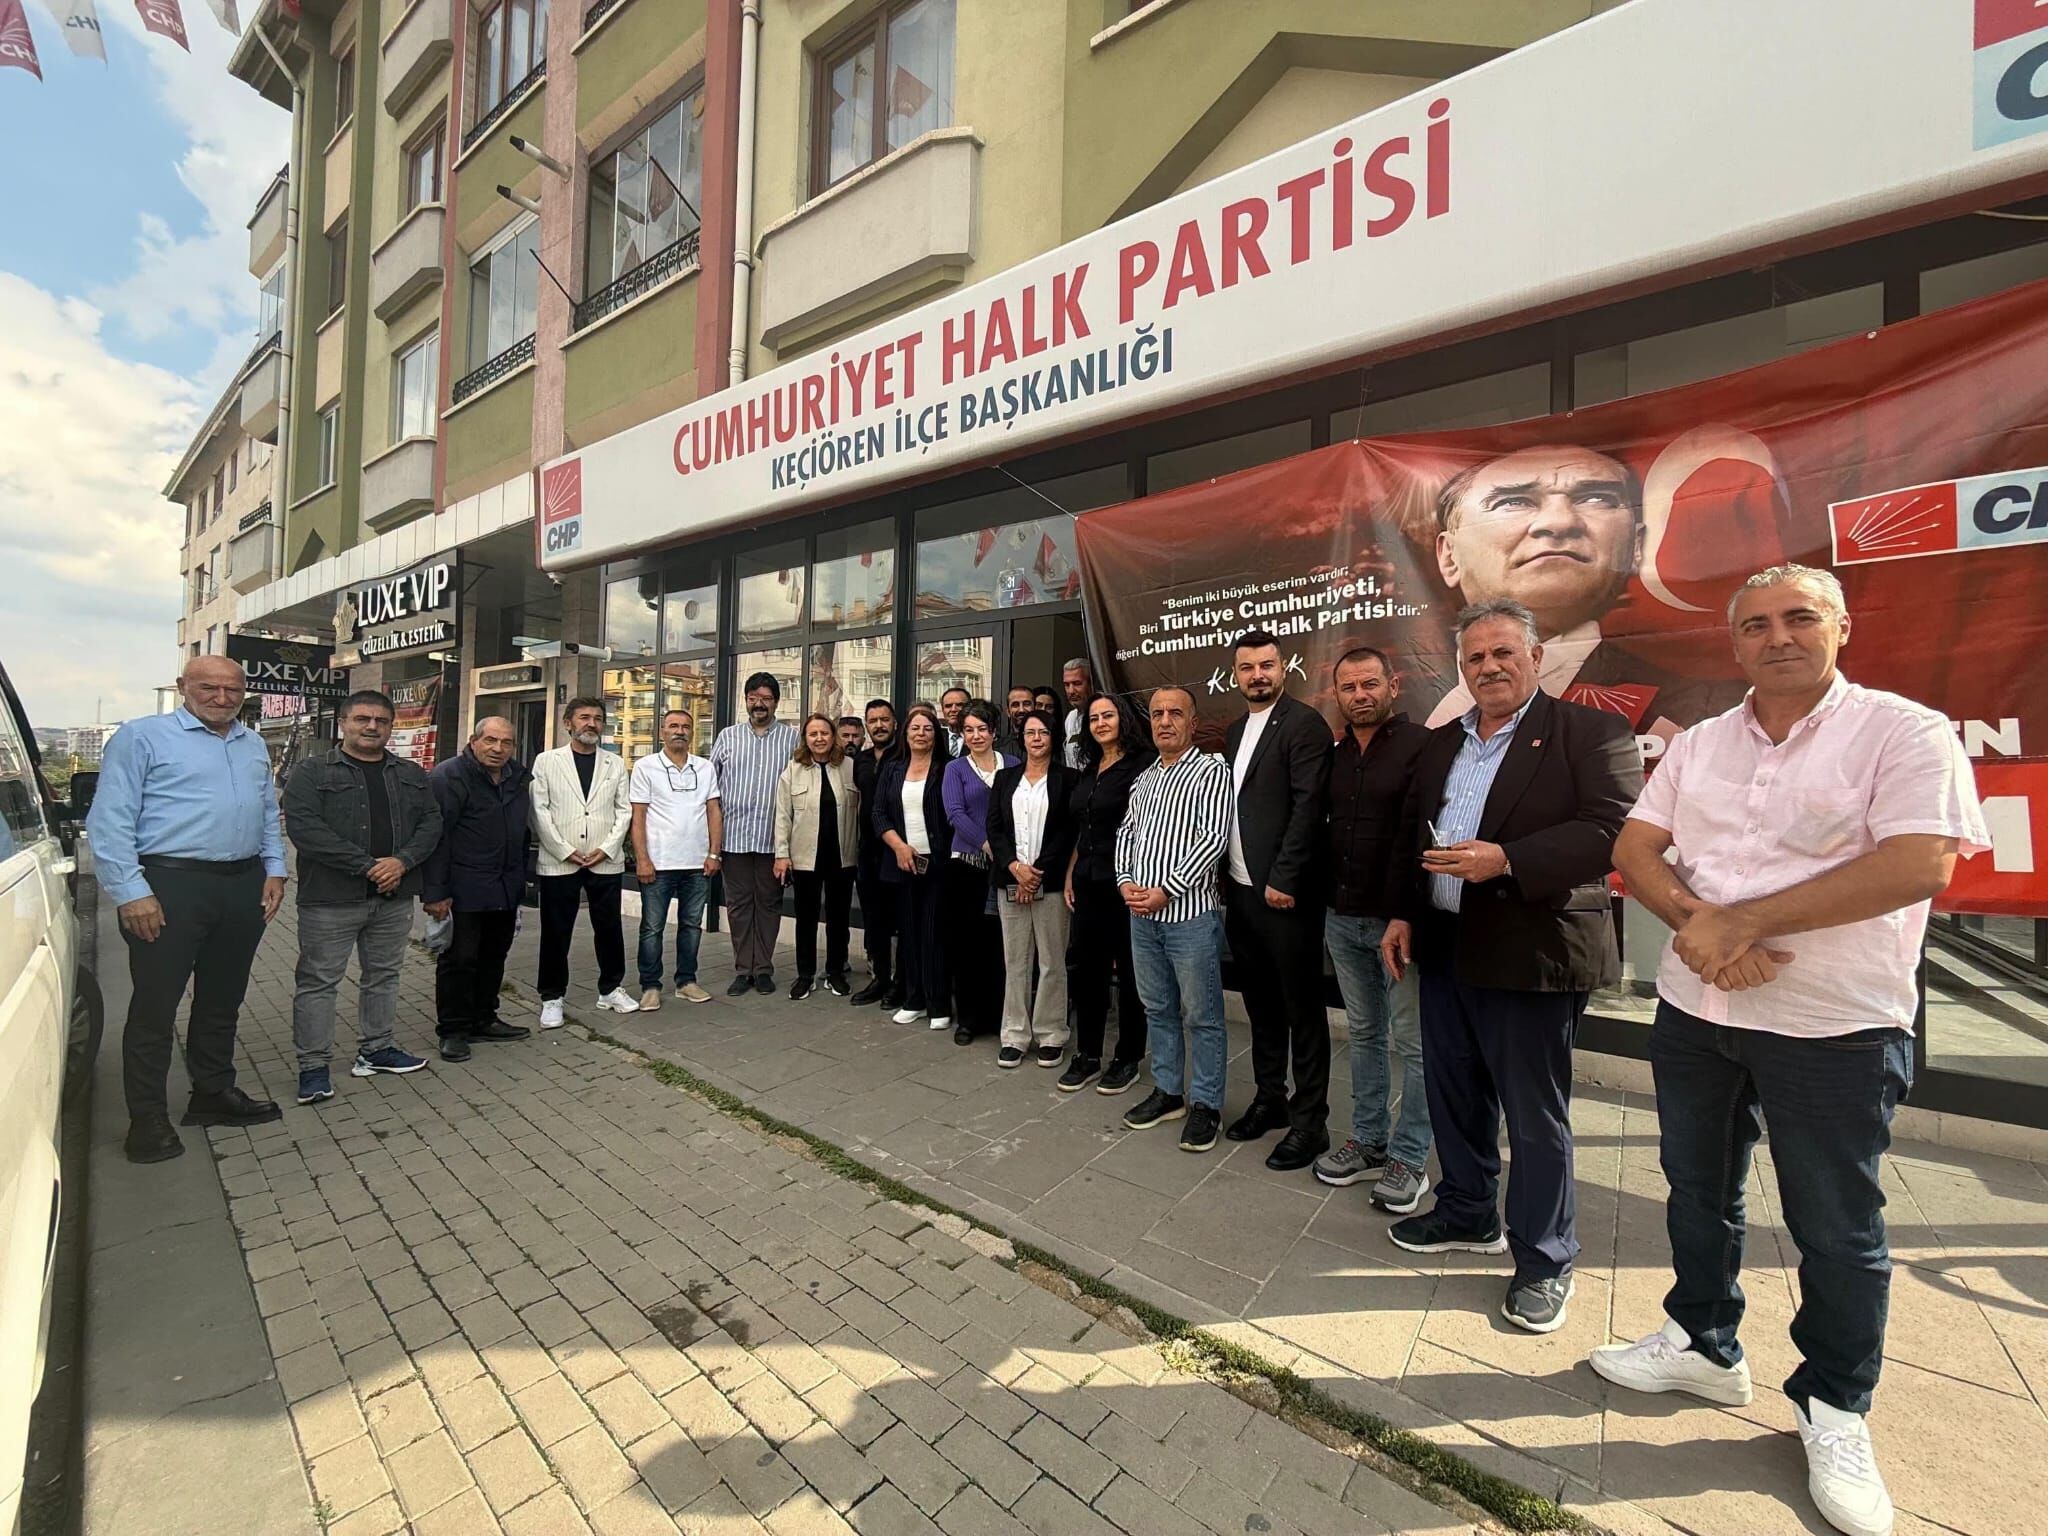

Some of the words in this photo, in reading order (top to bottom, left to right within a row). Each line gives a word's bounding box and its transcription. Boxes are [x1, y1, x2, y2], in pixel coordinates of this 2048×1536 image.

[673, 331, 922, 475] CUMHURİYET
[942, 262, 1091, 386] HALK
[1119, 98, 1450, 325] PARTİSİ
[772, 422, 884, 490] KEÇİÖREN
[896, 402, 948, 455] İLÇE
[960, 322, 1172, 431] BAŞKANLIĞI
[546, 520, 580, 552] CHP
[358, 576, 407, 627] LUXE
[411, 563, 449, 611] VIP
[1139, 623, 1159, 635] Biri
[1160, 607, 1234, 632] Türkiye
[1239, 576, 1381, 619] Cumhuriyeti,
[1205, 590, 1220, 603] iki
[1222, 583, 1260, 600] büyük
[1262, 576, 1307, 593] eserim
[362, 630, 399, 656] GÜZELLİK
[400, 632, 408, 647] &
[409, 619, 445, 646] ESTETİK
[1262, 614, 1312, 637] Halk
[241, 659, 299, 681] UXE
[302, 665, 345, 684] VIP
